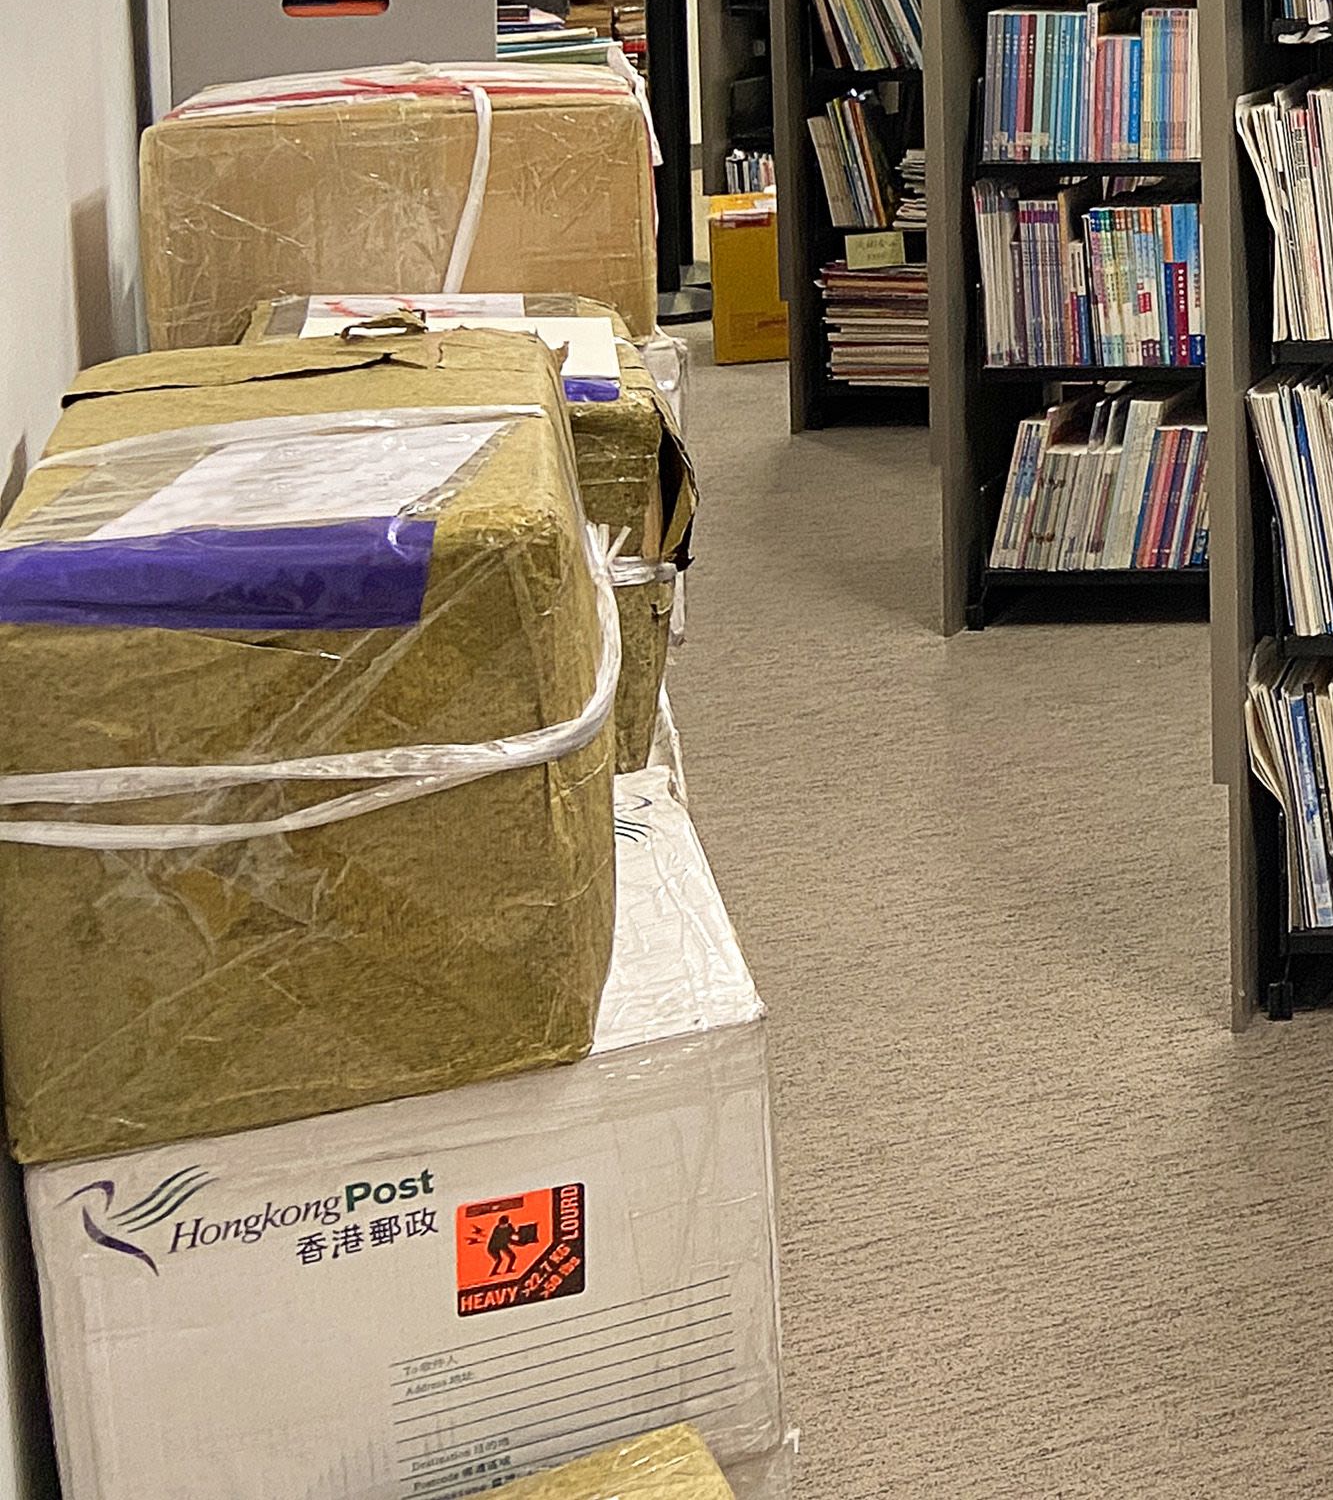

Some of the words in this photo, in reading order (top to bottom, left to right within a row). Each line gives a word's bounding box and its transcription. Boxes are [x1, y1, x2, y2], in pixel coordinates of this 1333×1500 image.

[296, 1206, 439, 1266] 香港郵政
[560, 1185, 580, 1241] LOURD
[460, 1286, 519, 1313] HEAVY
